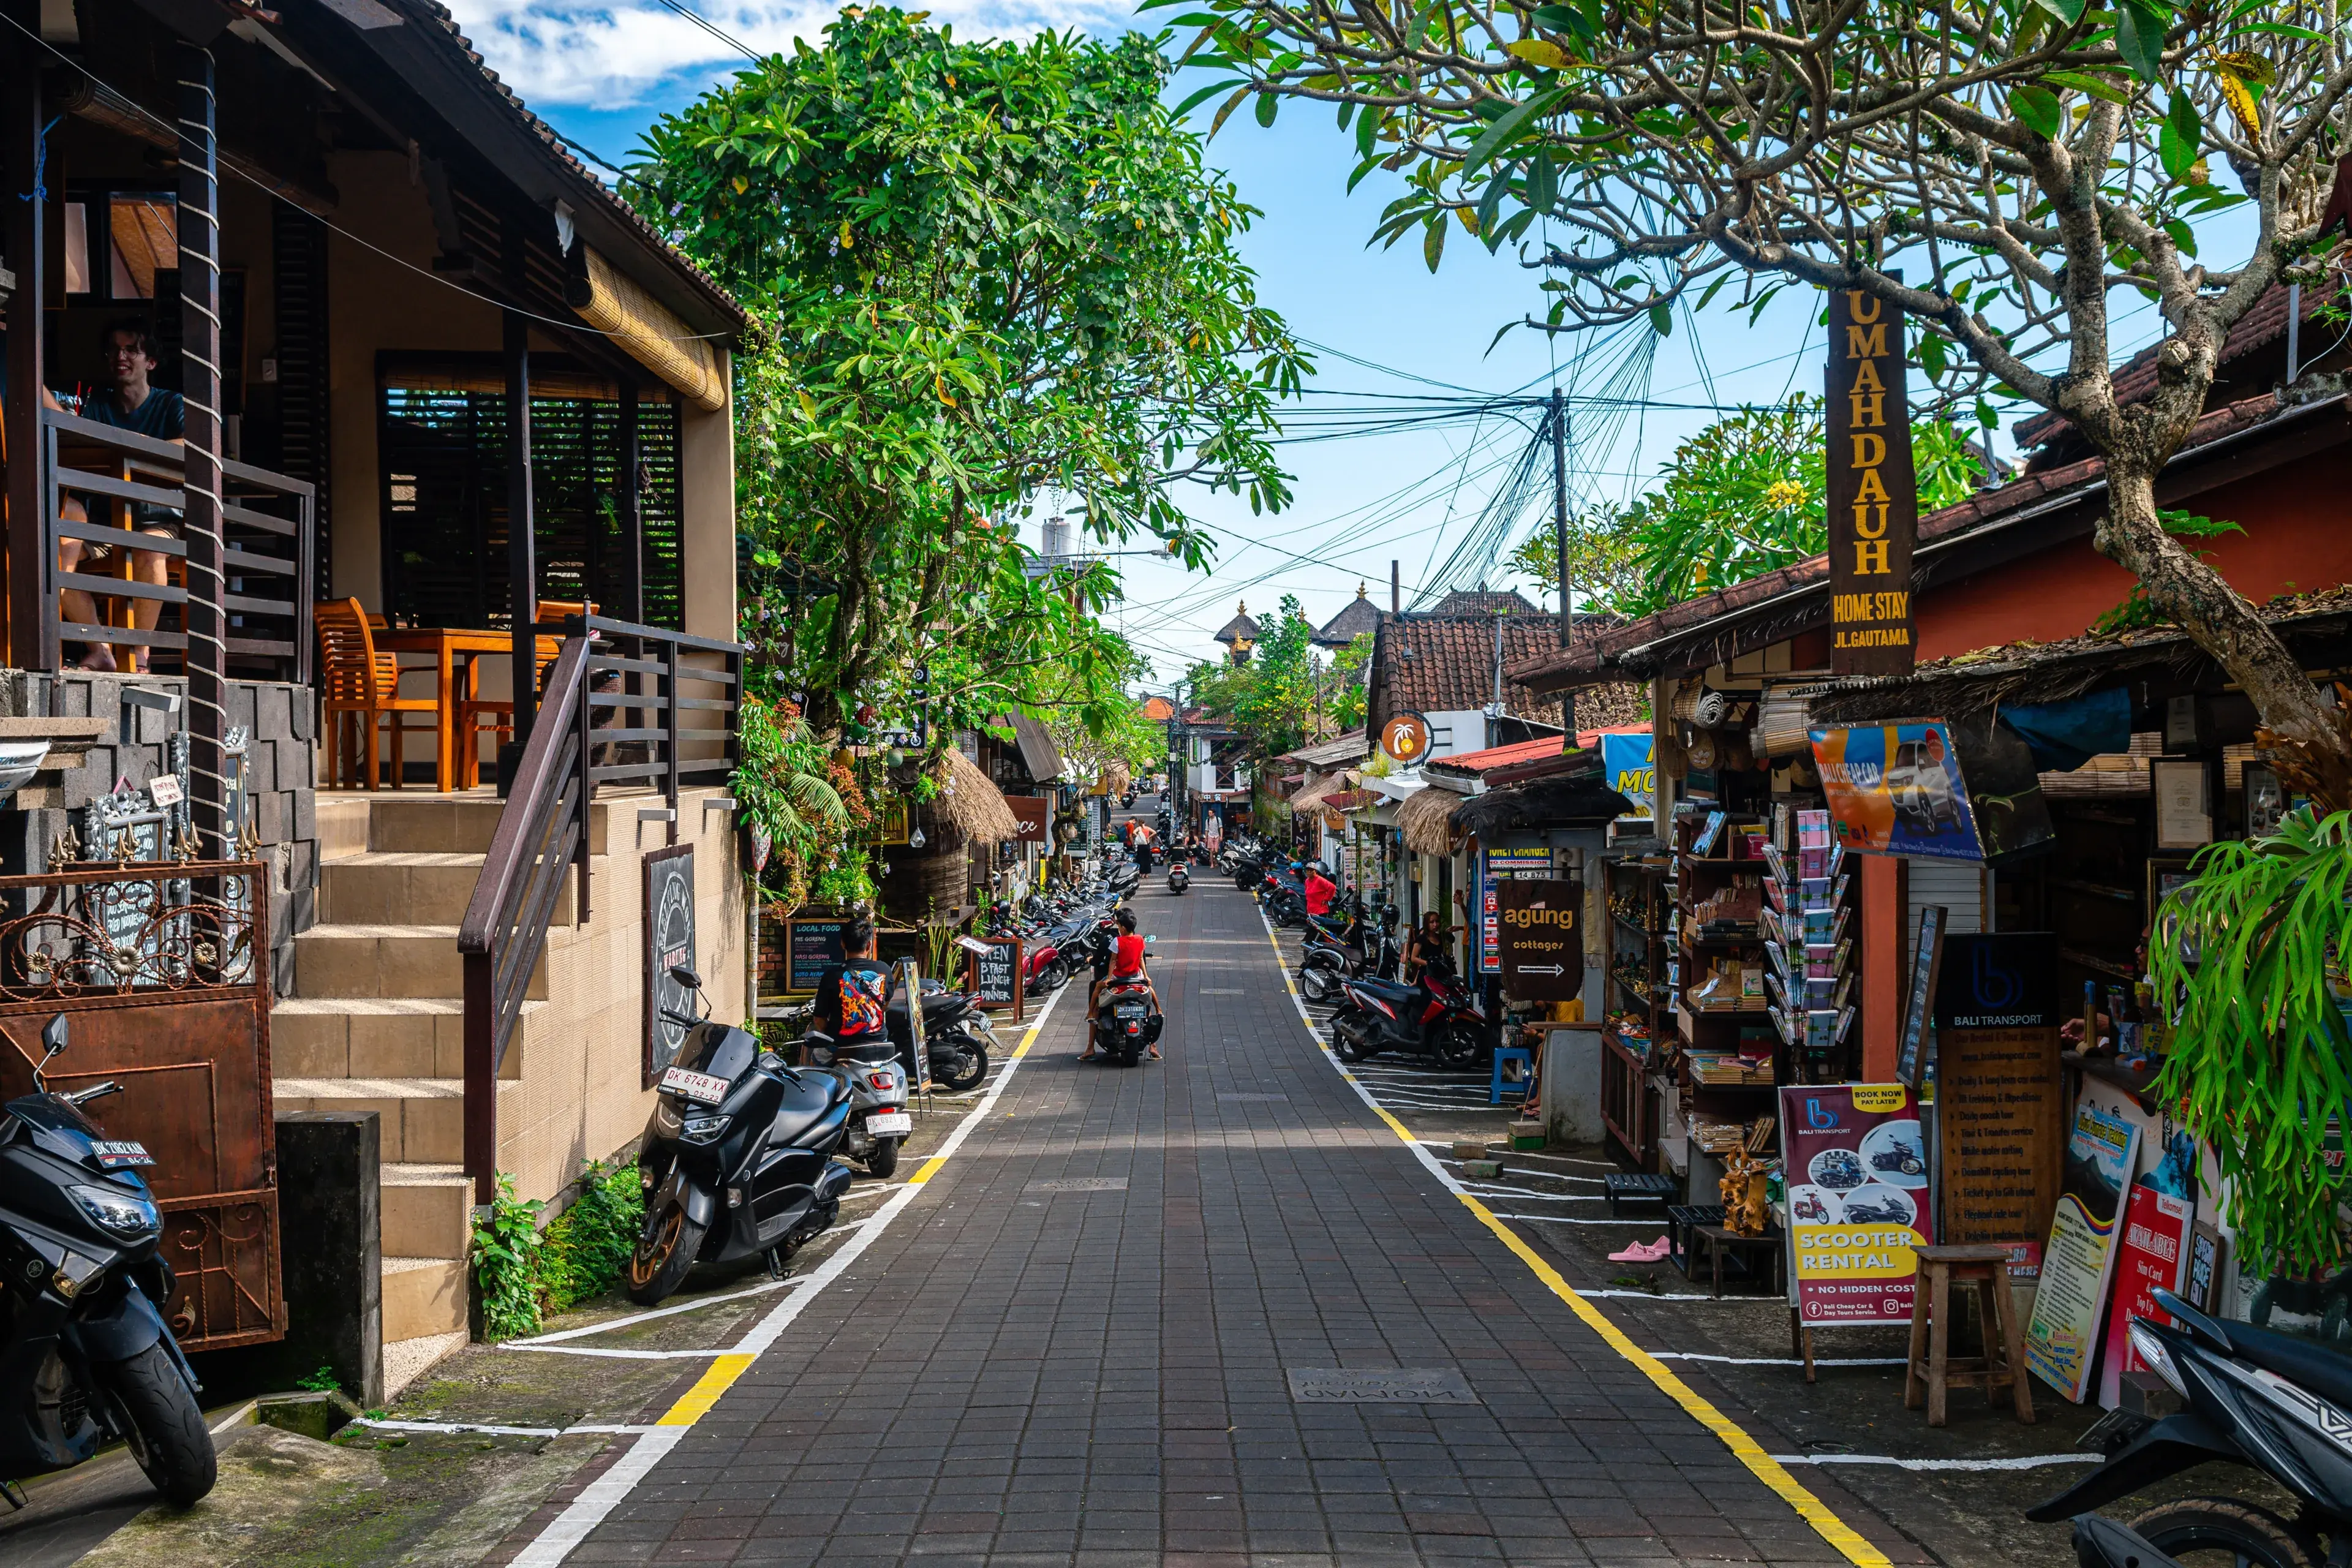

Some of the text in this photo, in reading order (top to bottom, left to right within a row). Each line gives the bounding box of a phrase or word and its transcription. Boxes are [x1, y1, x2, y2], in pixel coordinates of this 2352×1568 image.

[1834, 592, 1909, 622] HOME STAY
[1819, 763, 1882, 783] BALI CHEAP CAR
[1504, 908, 1573, 930] agung
[1513, 940, 1564, 951] cottages
[663, 946, 687, 971] WARUNG
[981, 962, 1011, 975] B'FAST
[980, 975, 1012, 986] LUNCH
[981, 990, 1011, 1001] DINNER
[1954, 1014, 2043, 1026] BALI TRANSPORT
[668, 1070, 726, 1092] DK 6748 XX
[91, 1142, 110, 1155] DK
[2162, 1198, 2183, 1215] Telkomsel
[1800, 1232, 1913, 1248] SCOOTER
[2125, 1222, 2177, 1264] AVAILABLE
[1803, 1254, 1896, 1269] RENTAL
[2137, 1260, 2163, 1282] Sim Card
[2136, 1294, 2154, 1315] Top Up
[1303, 1390, 1458, 1399] NOMAD
